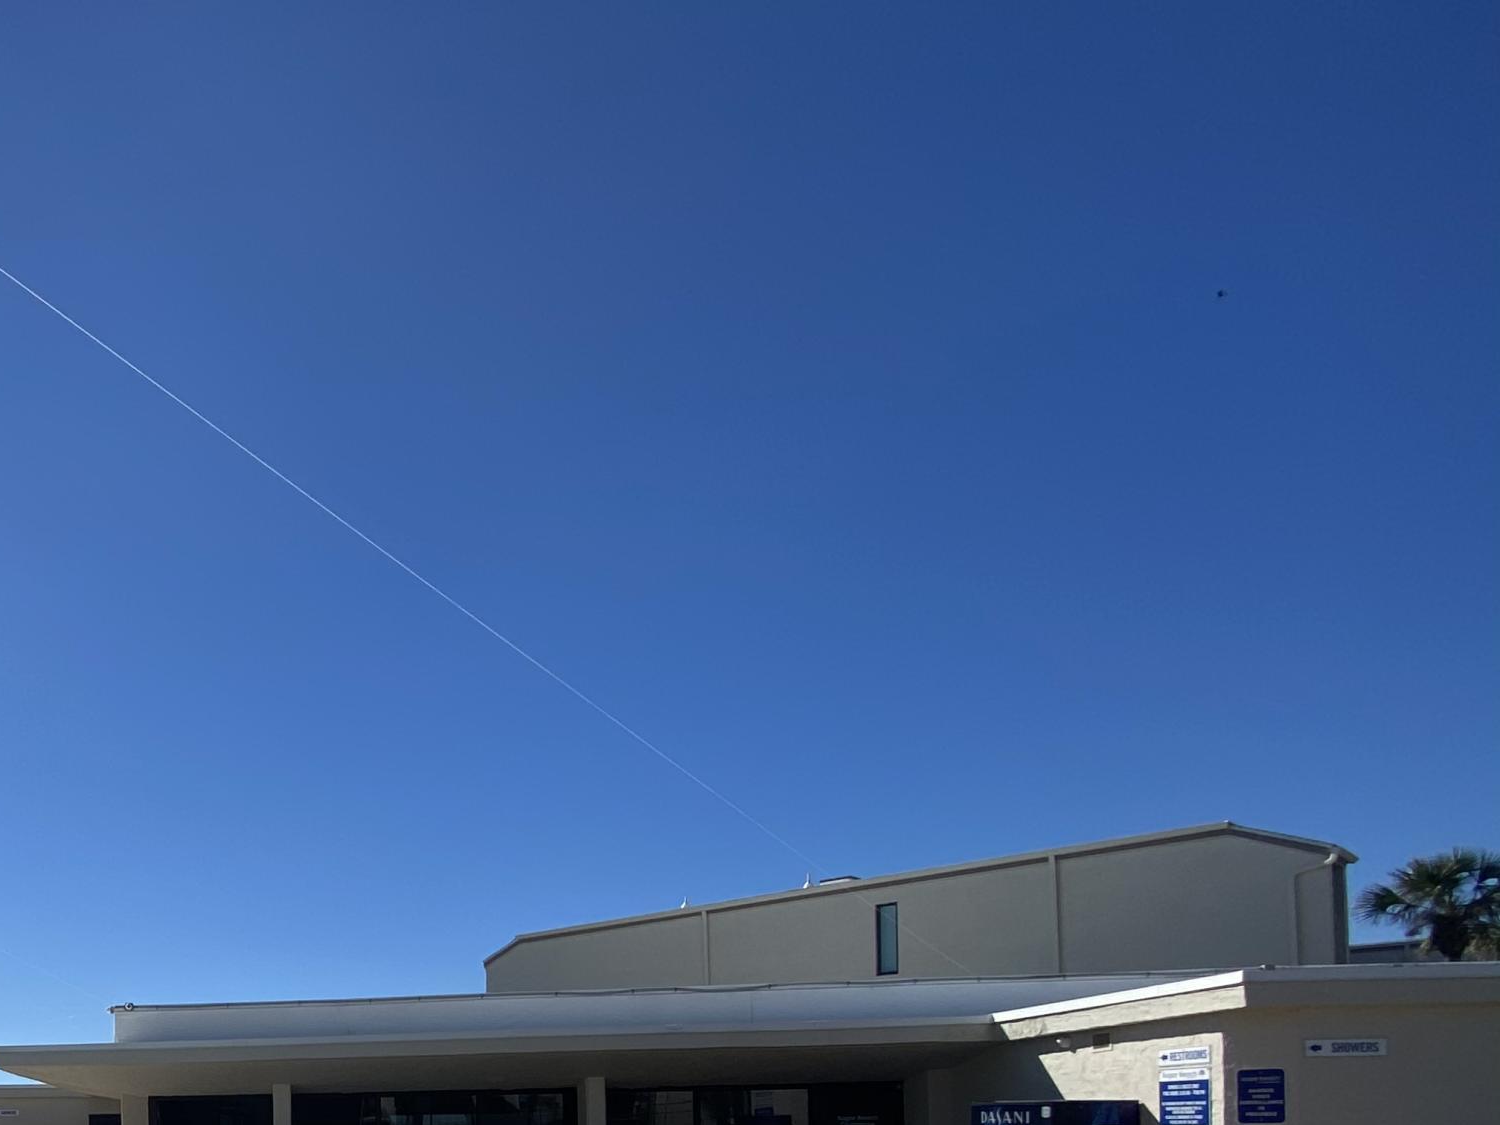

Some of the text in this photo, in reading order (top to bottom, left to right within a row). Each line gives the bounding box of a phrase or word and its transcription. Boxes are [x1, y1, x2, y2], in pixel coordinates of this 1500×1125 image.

[1331, 1042, 1380, 1053] SHOWERS
[1169, 1049, 1207, 1061] RESTROOMS
[980, 1108, 1030, 1125] DASANI
